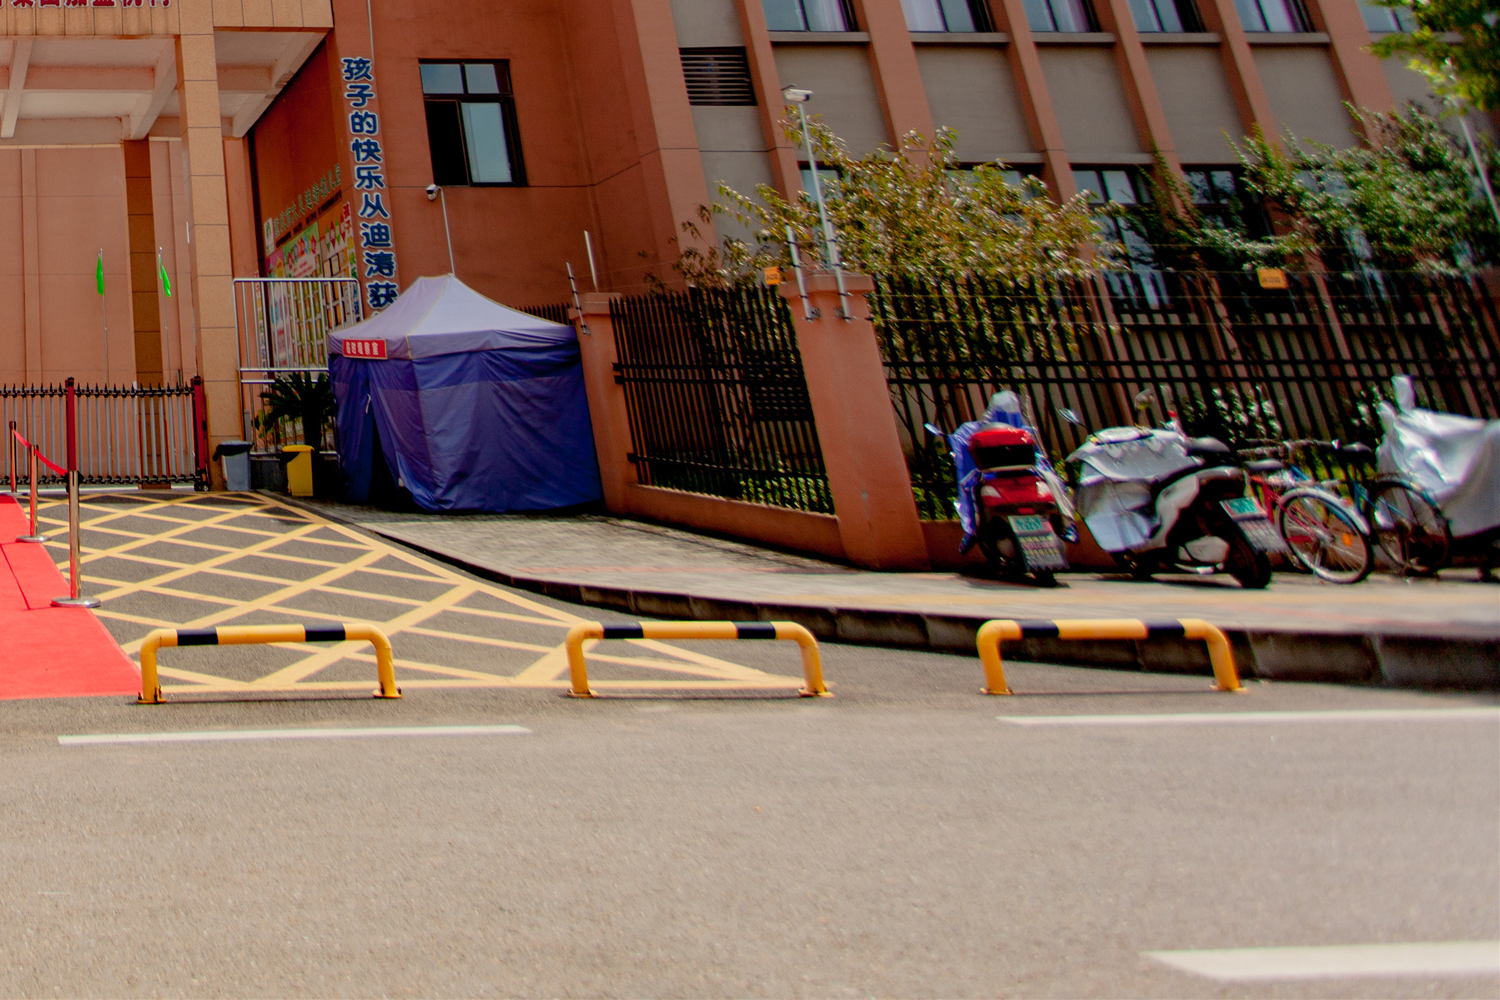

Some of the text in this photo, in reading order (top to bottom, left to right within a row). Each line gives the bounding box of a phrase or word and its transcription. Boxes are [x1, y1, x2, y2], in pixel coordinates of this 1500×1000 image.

[341, 57, 399, 314] 孩子的快乐从迪涛获
